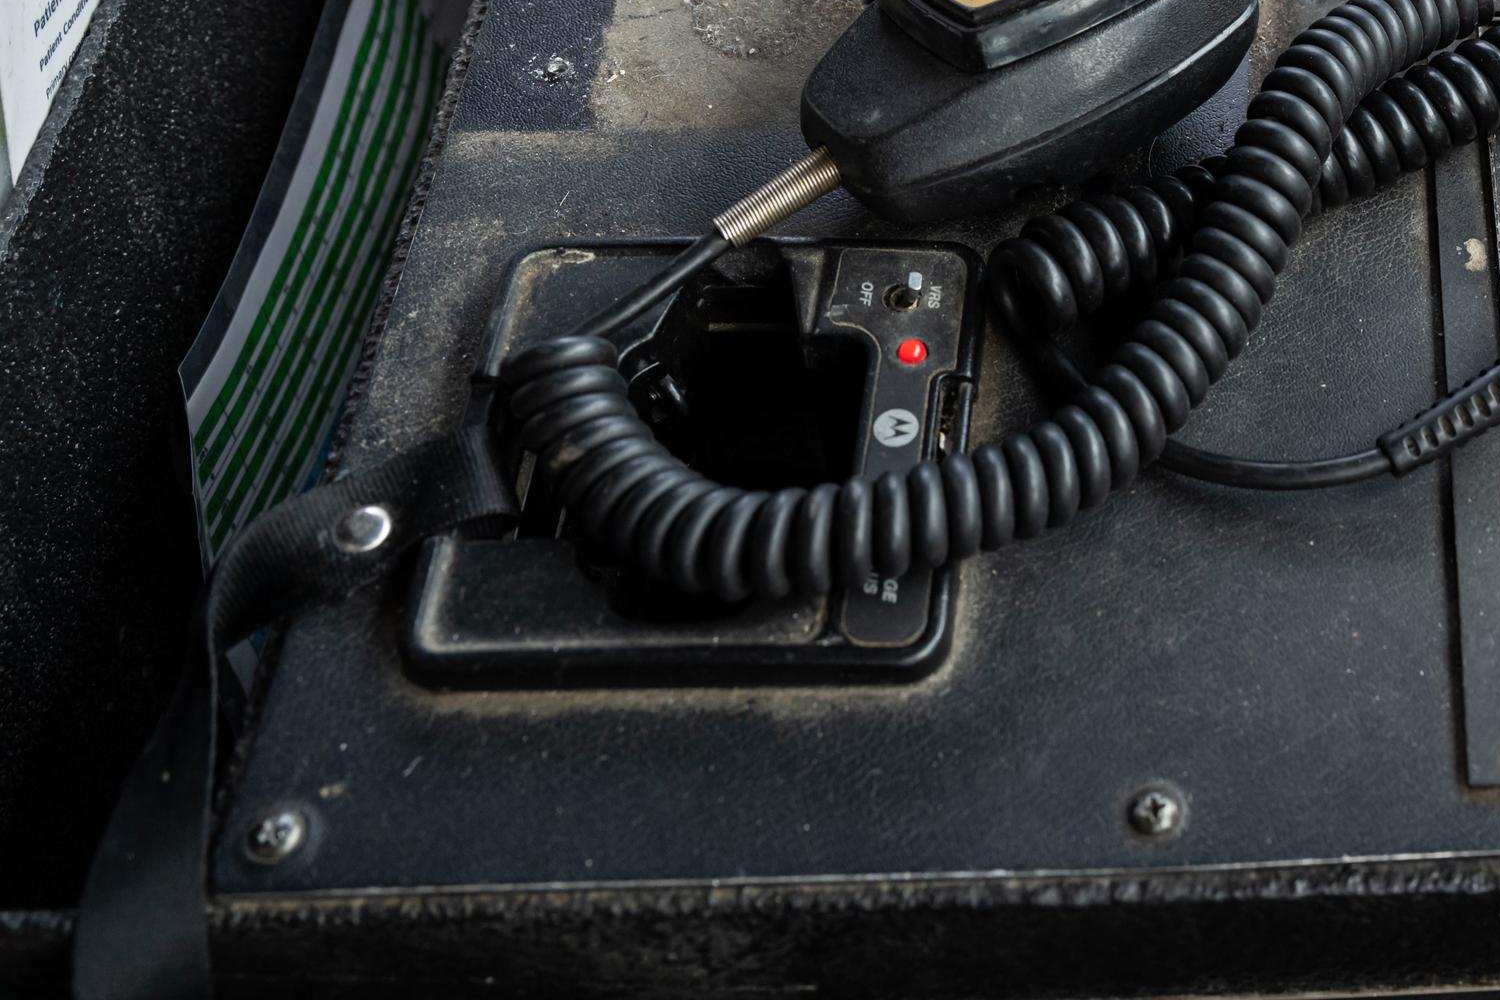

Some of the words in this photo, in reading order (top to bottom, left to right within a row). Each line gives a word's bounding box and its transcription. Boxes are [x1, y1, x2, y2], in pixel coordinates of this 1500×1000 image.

[40, 31, 63, 72] Patient
[860, 281, 874, 307] OFF
[928, 284, 943, 310] VRS
